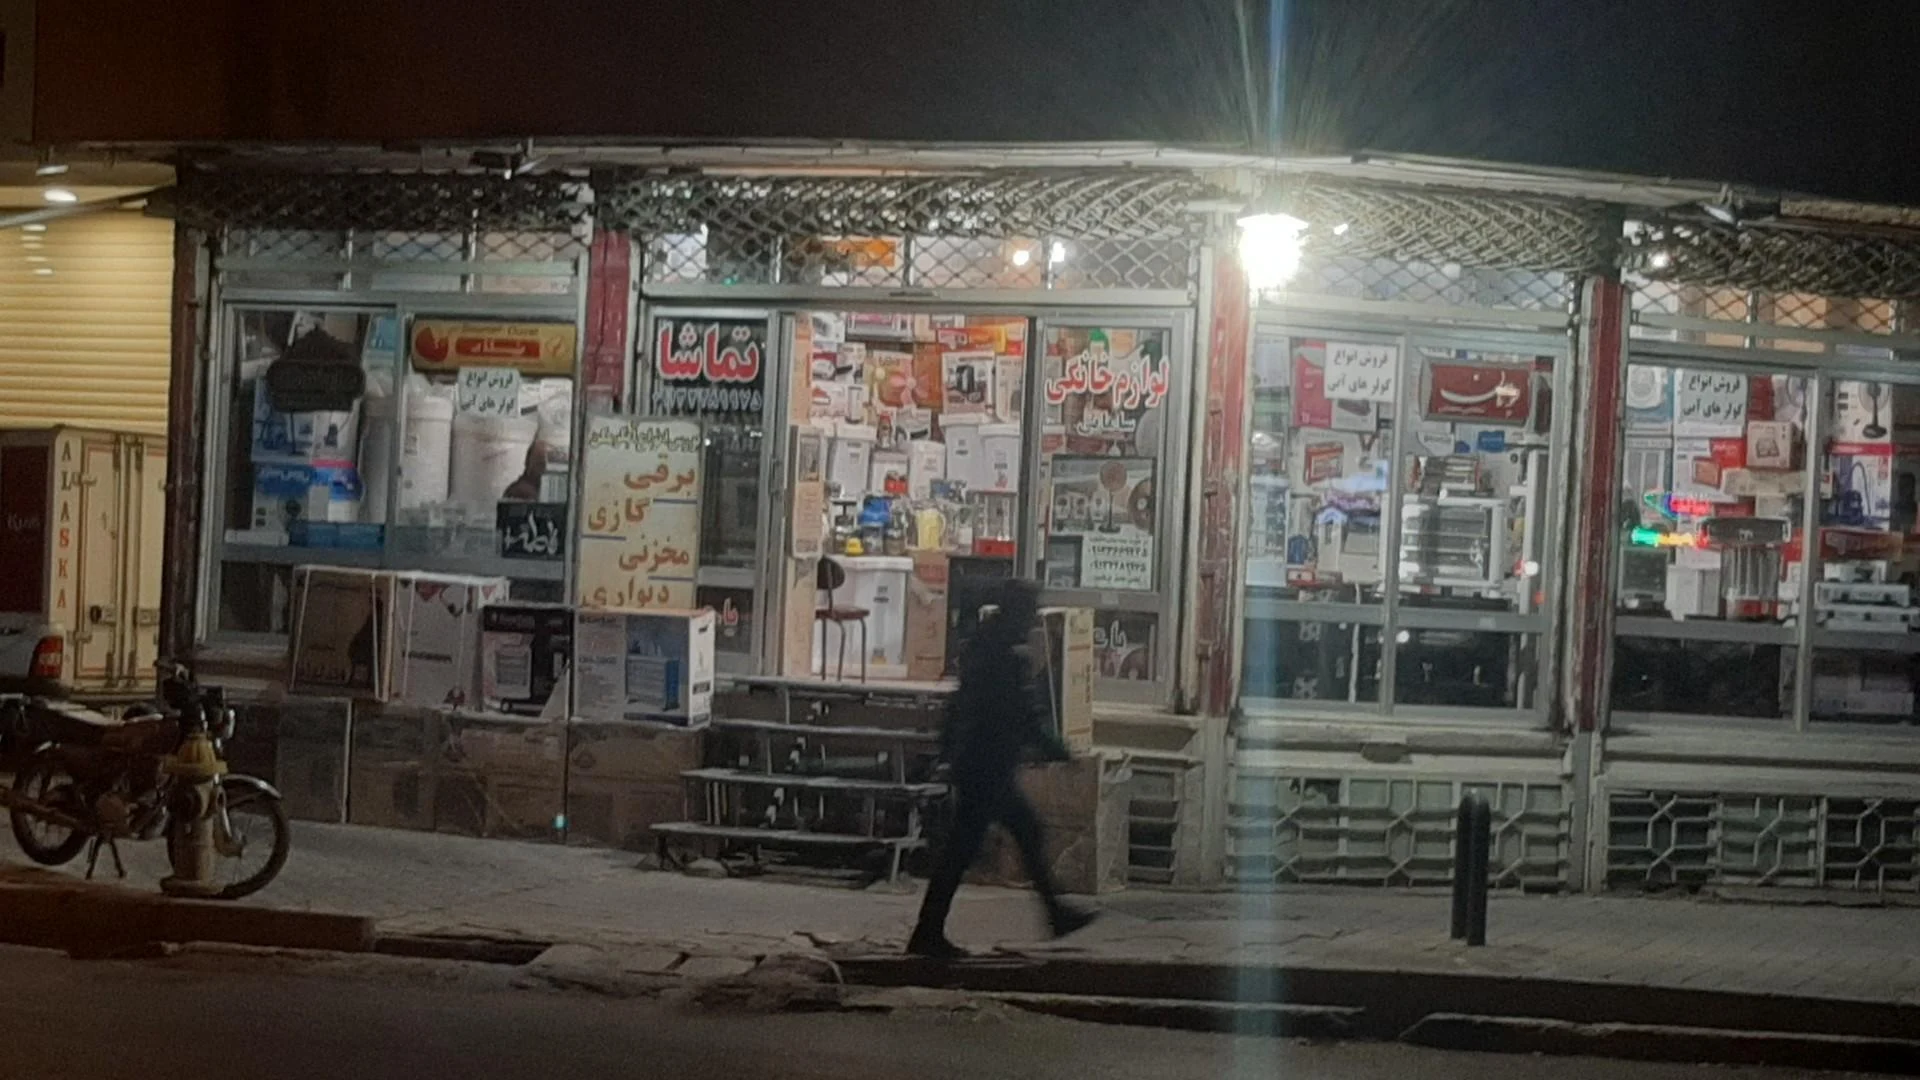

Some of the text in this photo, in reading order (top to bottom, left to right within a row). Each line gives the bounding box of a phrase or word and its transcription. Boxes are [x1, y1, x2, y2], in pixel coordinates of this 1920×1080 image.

[658, 319, 760, 383] تماشا
[1333, 349, 1388, 369] فروش انواع
[488, 371, 513, 388] فروش
[1044, 350, 1170, 409] لوازم خانگی
[1348, 376, 1367, 393] های
[1688, 374, 1740, 394] فروش انواع
[1702, 400, 1721, 418] های
[623, 453, 696, 497] برقی
[618, 534, 690, 573] مخزنی
